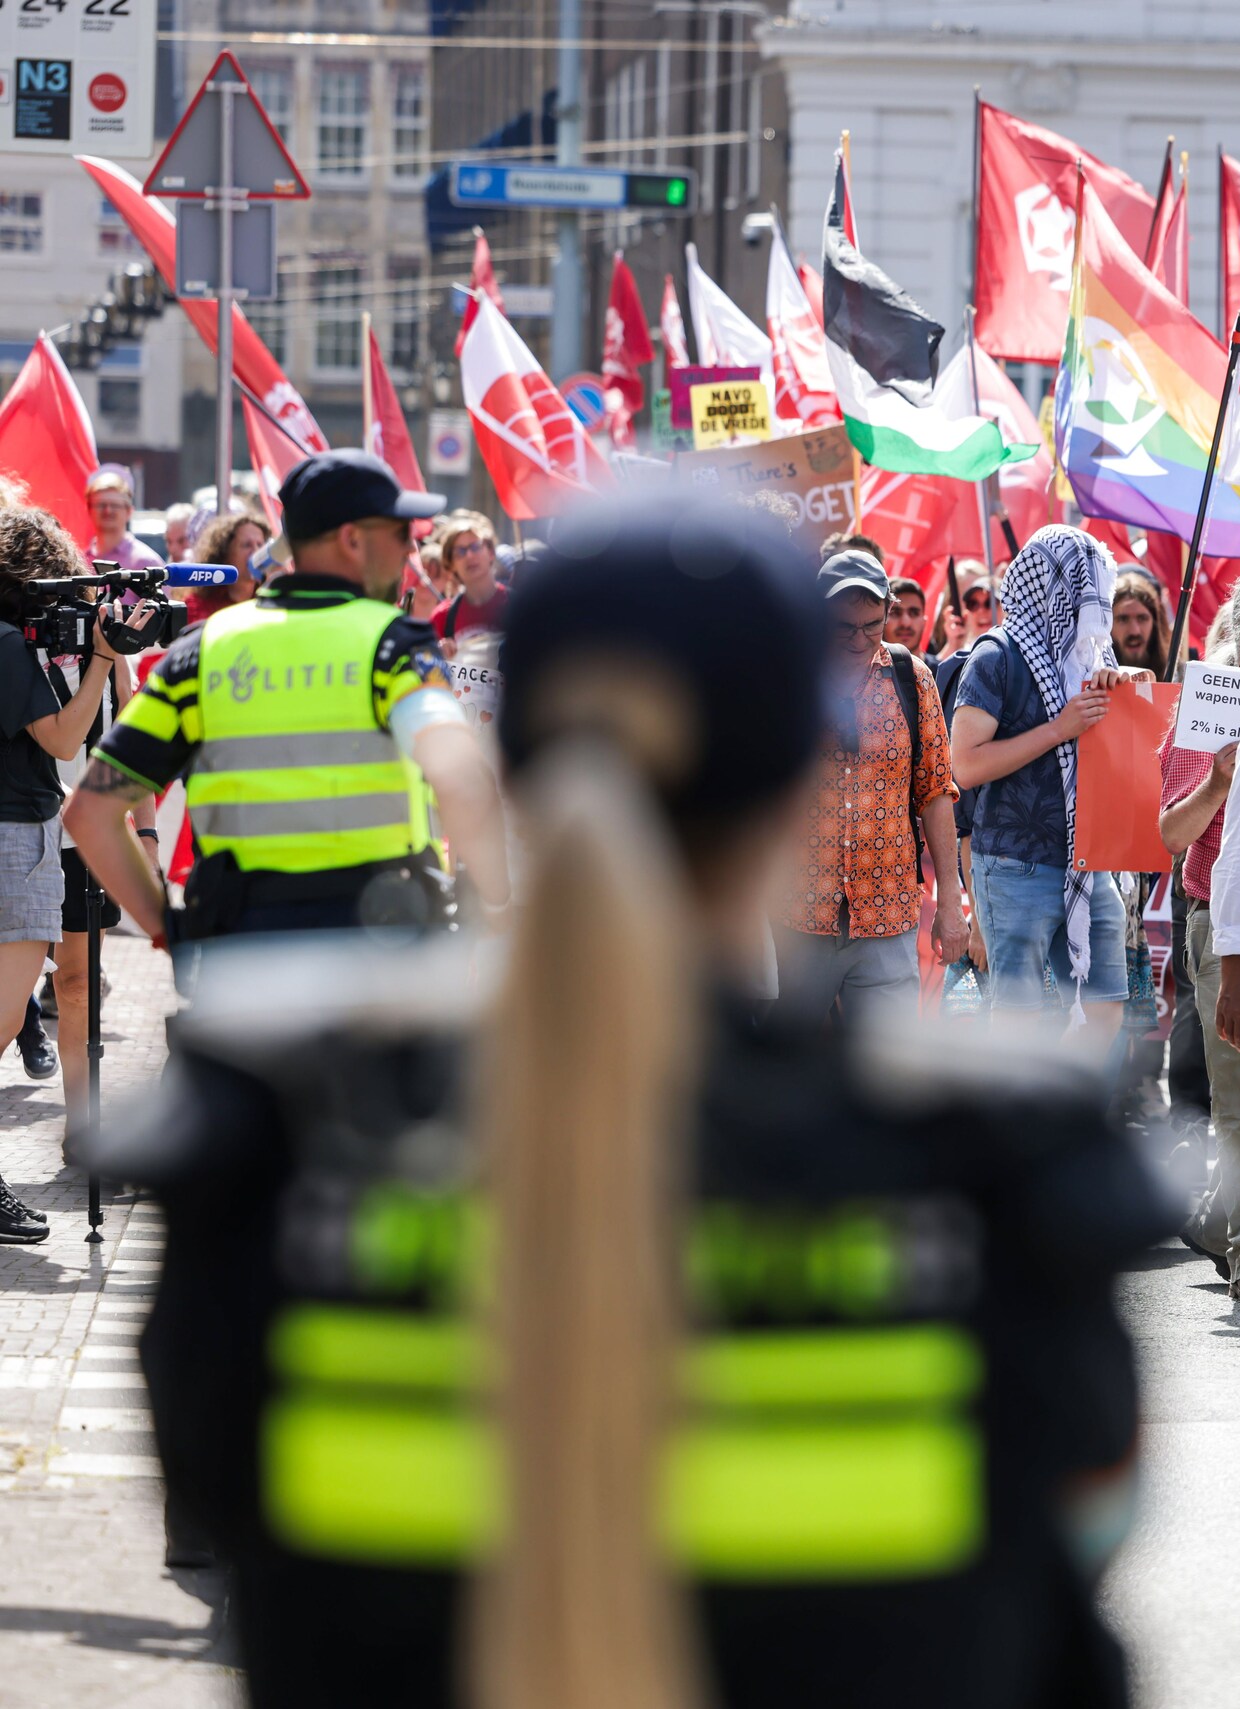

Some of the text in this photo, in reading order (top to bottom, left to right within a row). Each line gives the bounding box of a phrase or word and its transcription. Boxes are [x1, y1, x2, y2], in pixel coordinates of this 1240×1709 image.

[19, 60, 68, 91] N3
[711, 388, 752, 401] NAVO
[700, 417, 768, 433] DE VREDE
[728, 461, 797, 484] There's
[188, 570, 213, 582] AFP
[1202, 673, 1240, 690] GEEN
[1190, 719, 1211, 734] 2%
[1214, 723, 1225, 736] is
[1229, 727, 1240, 738] al
